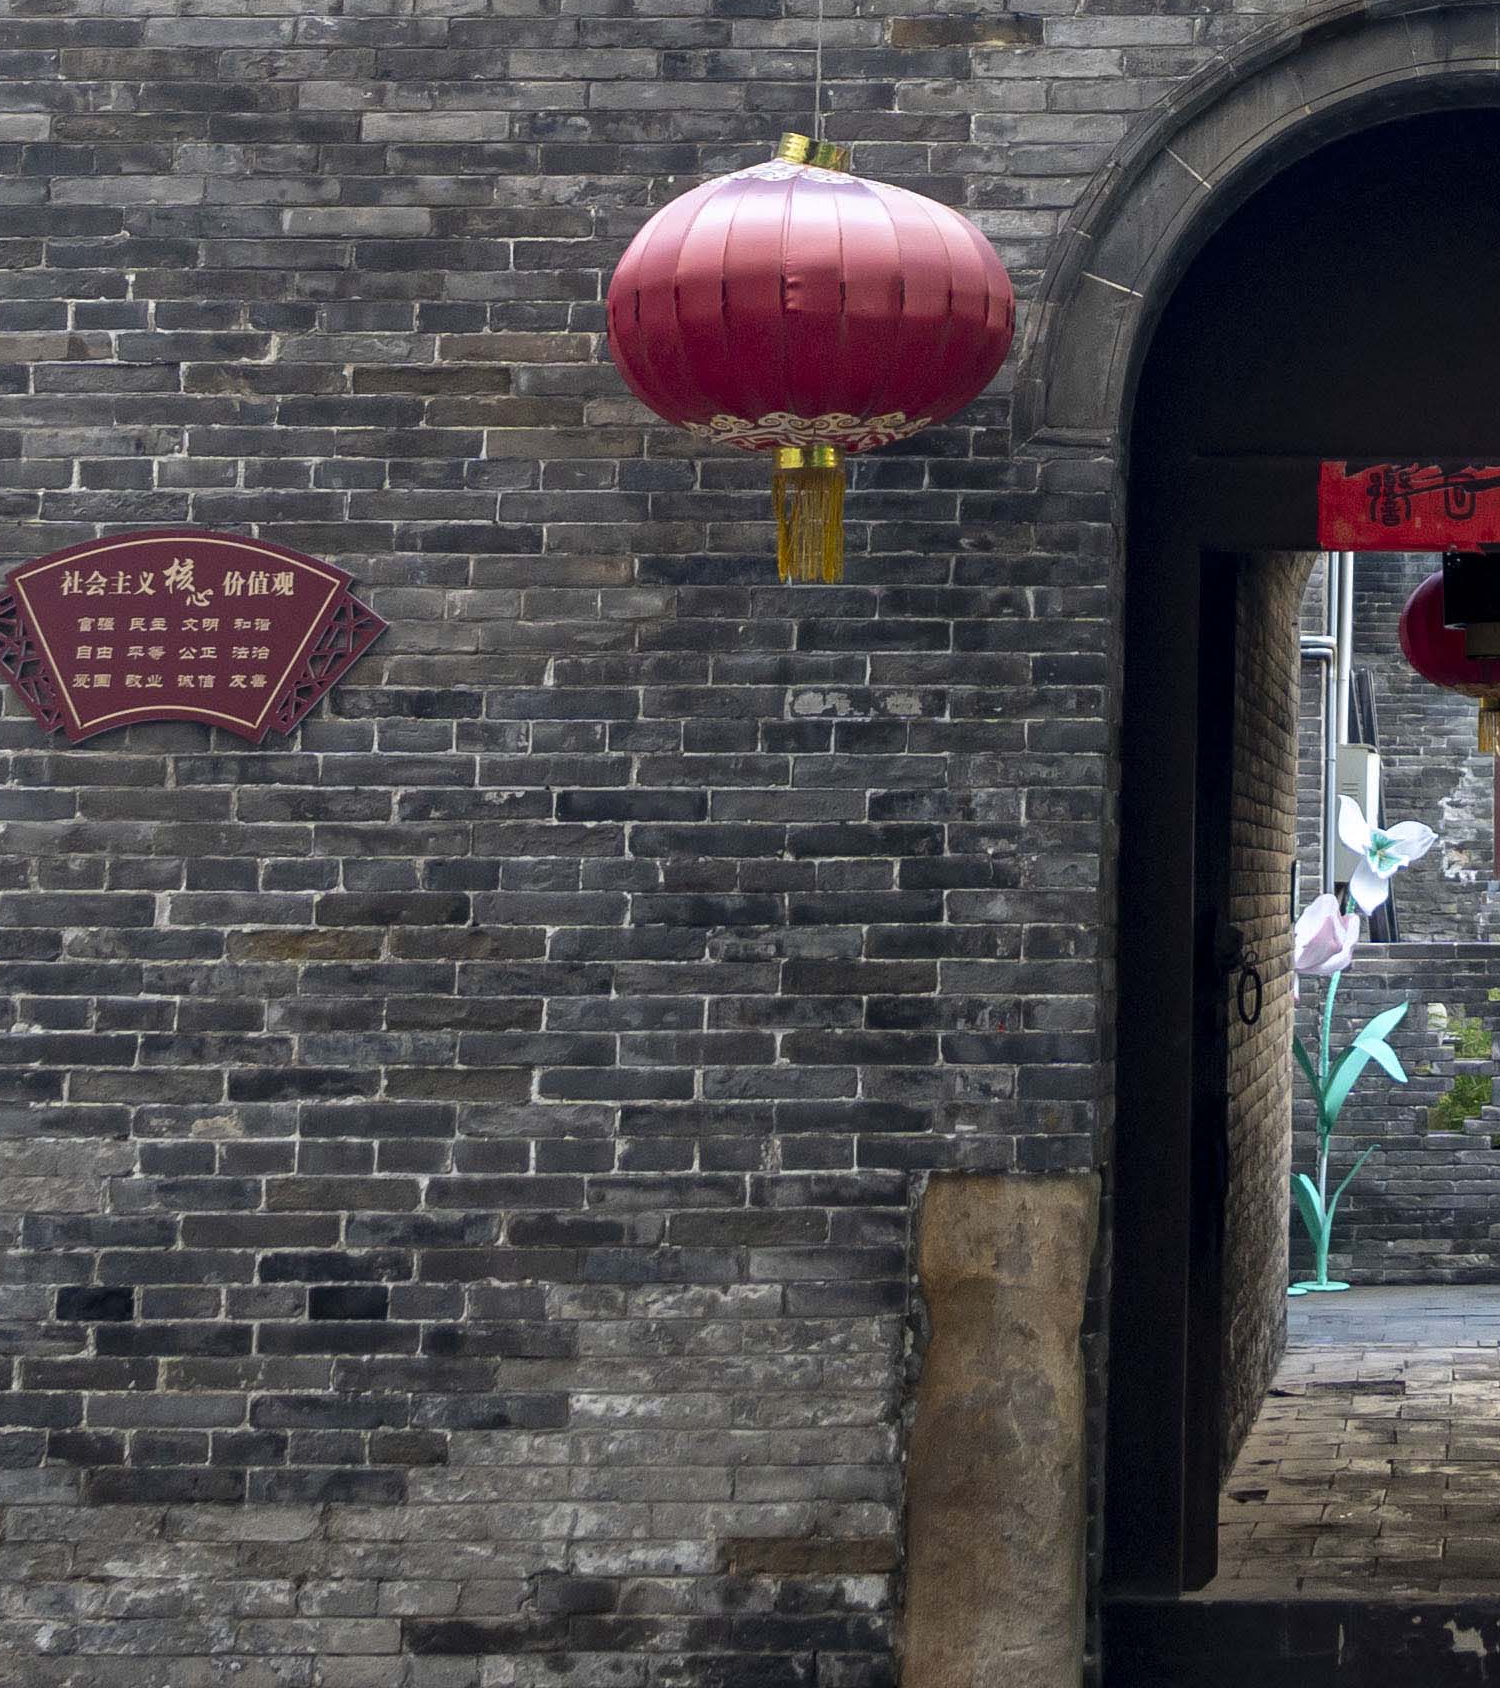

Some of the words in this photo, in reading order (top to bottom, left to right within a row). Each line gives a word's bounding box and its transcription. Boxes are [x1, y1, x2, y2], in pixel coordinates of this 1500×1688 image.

[129, 617, 168, 631] 民主
[181, 618, 219, 632] 文明
[76, 645, 113, 660] 自由
[127, 645, 167, 660] 平等
[178, 646, 217, 660] 公正
[232, 646, 270, 660] 法治
[125, 674, 164, 688] 敬业
[178, 674, 216, 688] 诚信
[229, 674, 268, 688] 友善
